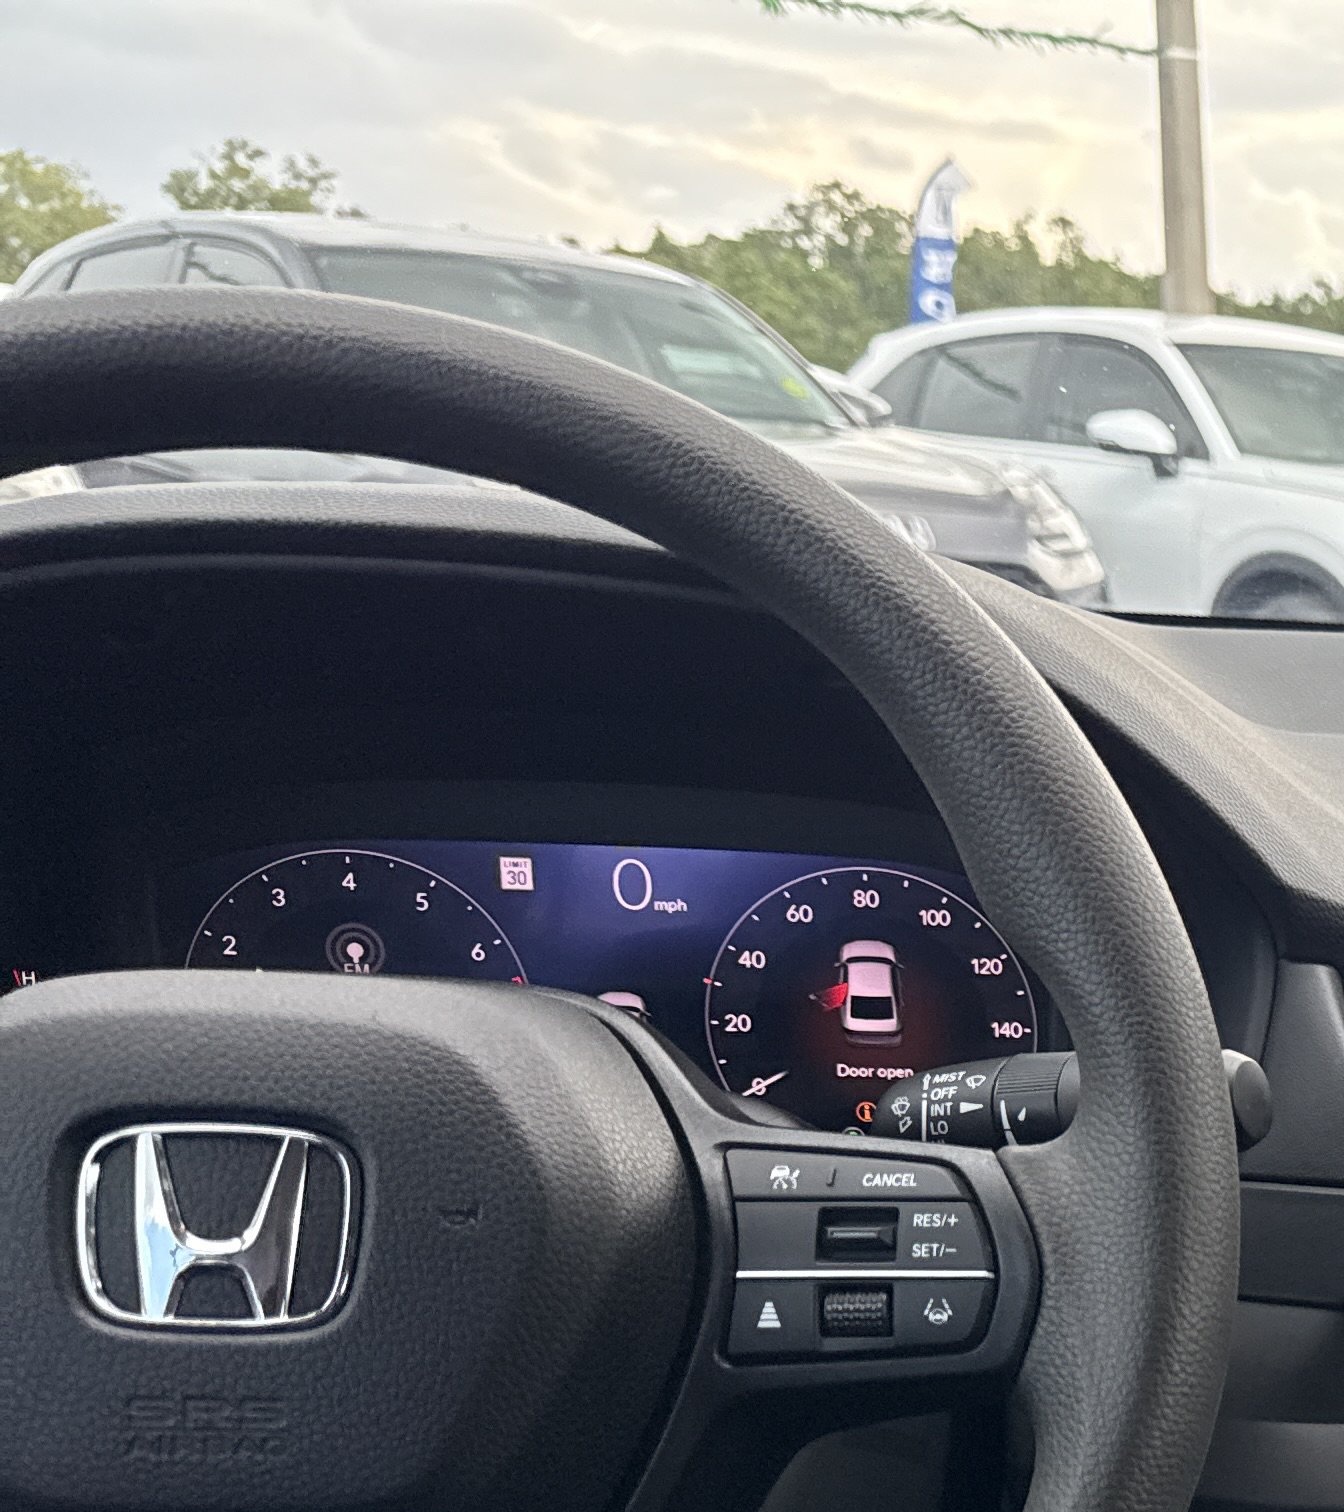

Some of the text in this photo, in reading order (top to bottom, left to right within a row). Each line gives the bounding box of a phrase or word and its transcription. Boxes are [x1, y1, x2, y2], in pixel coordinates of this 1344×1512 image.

[502, 860, 528, 868] LIMIT
[342, 872, 357, 891] 4
[506, 870, 527, 886] 30
[611, 858, 687, 914] 0 mph
[271, 888, 286, 907] 3
[415, 892, 429, 912] 5
[853, 890, 880, 908] 80
[786, 905, 813, 924] 60
[919, 909, 952, 928] 100
[222, 936, 238, 955] 2
[471, 943, 486, 962] 6
[739, 951, 766, 969] 40
[971, 958, 1003, 976] 120
[22, 971, 36, 985] H
[725, 1014, 752, 1033] 20
[991, 1022, 1024, 1040] 140
[836, 1063, 914, 1080] Door open
[932, 1071, 966, 1085] MIST
[930, 1086, 958, 1100] OFF
[930, 1102, 953, 1117] INT
[930, 1121, 949, 1135] LO
[862, 1173, 918, 1188] CANCEL
[913, 1213, 959, 1228] RES/+
